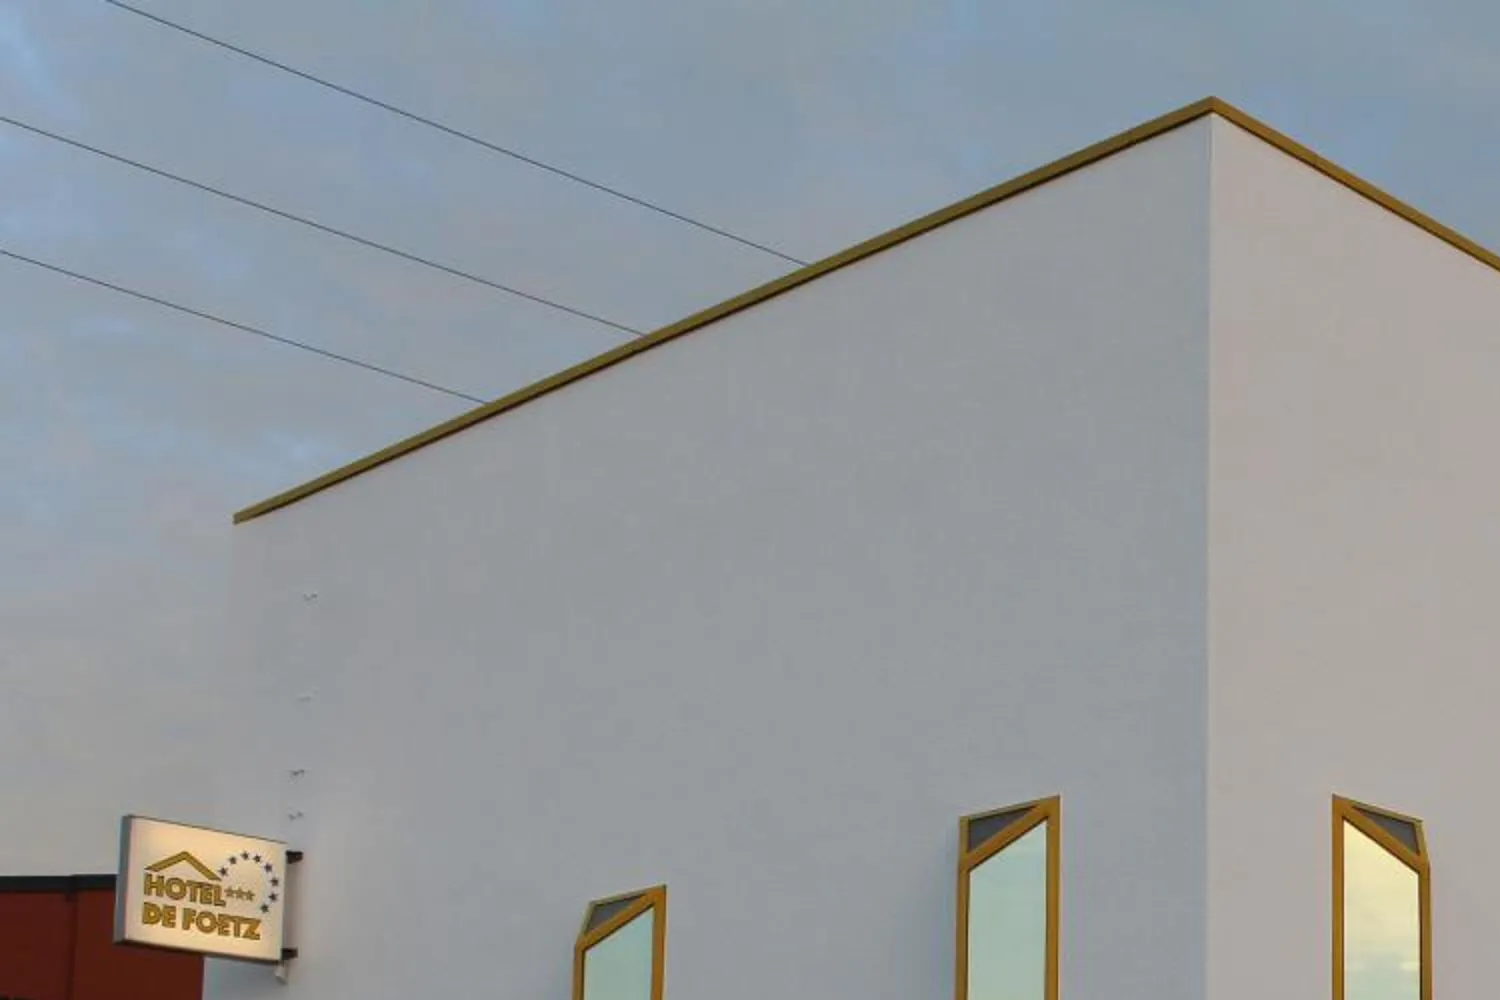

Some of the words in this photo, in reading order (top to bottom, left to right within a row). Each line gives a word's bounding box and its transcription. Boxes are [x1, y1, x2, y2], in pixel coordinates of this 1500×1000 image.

[144, 873, 227, 907] HOTEL
[142, 902, 176, 929] DE
[182, 907, 262, 941] FOETZ
